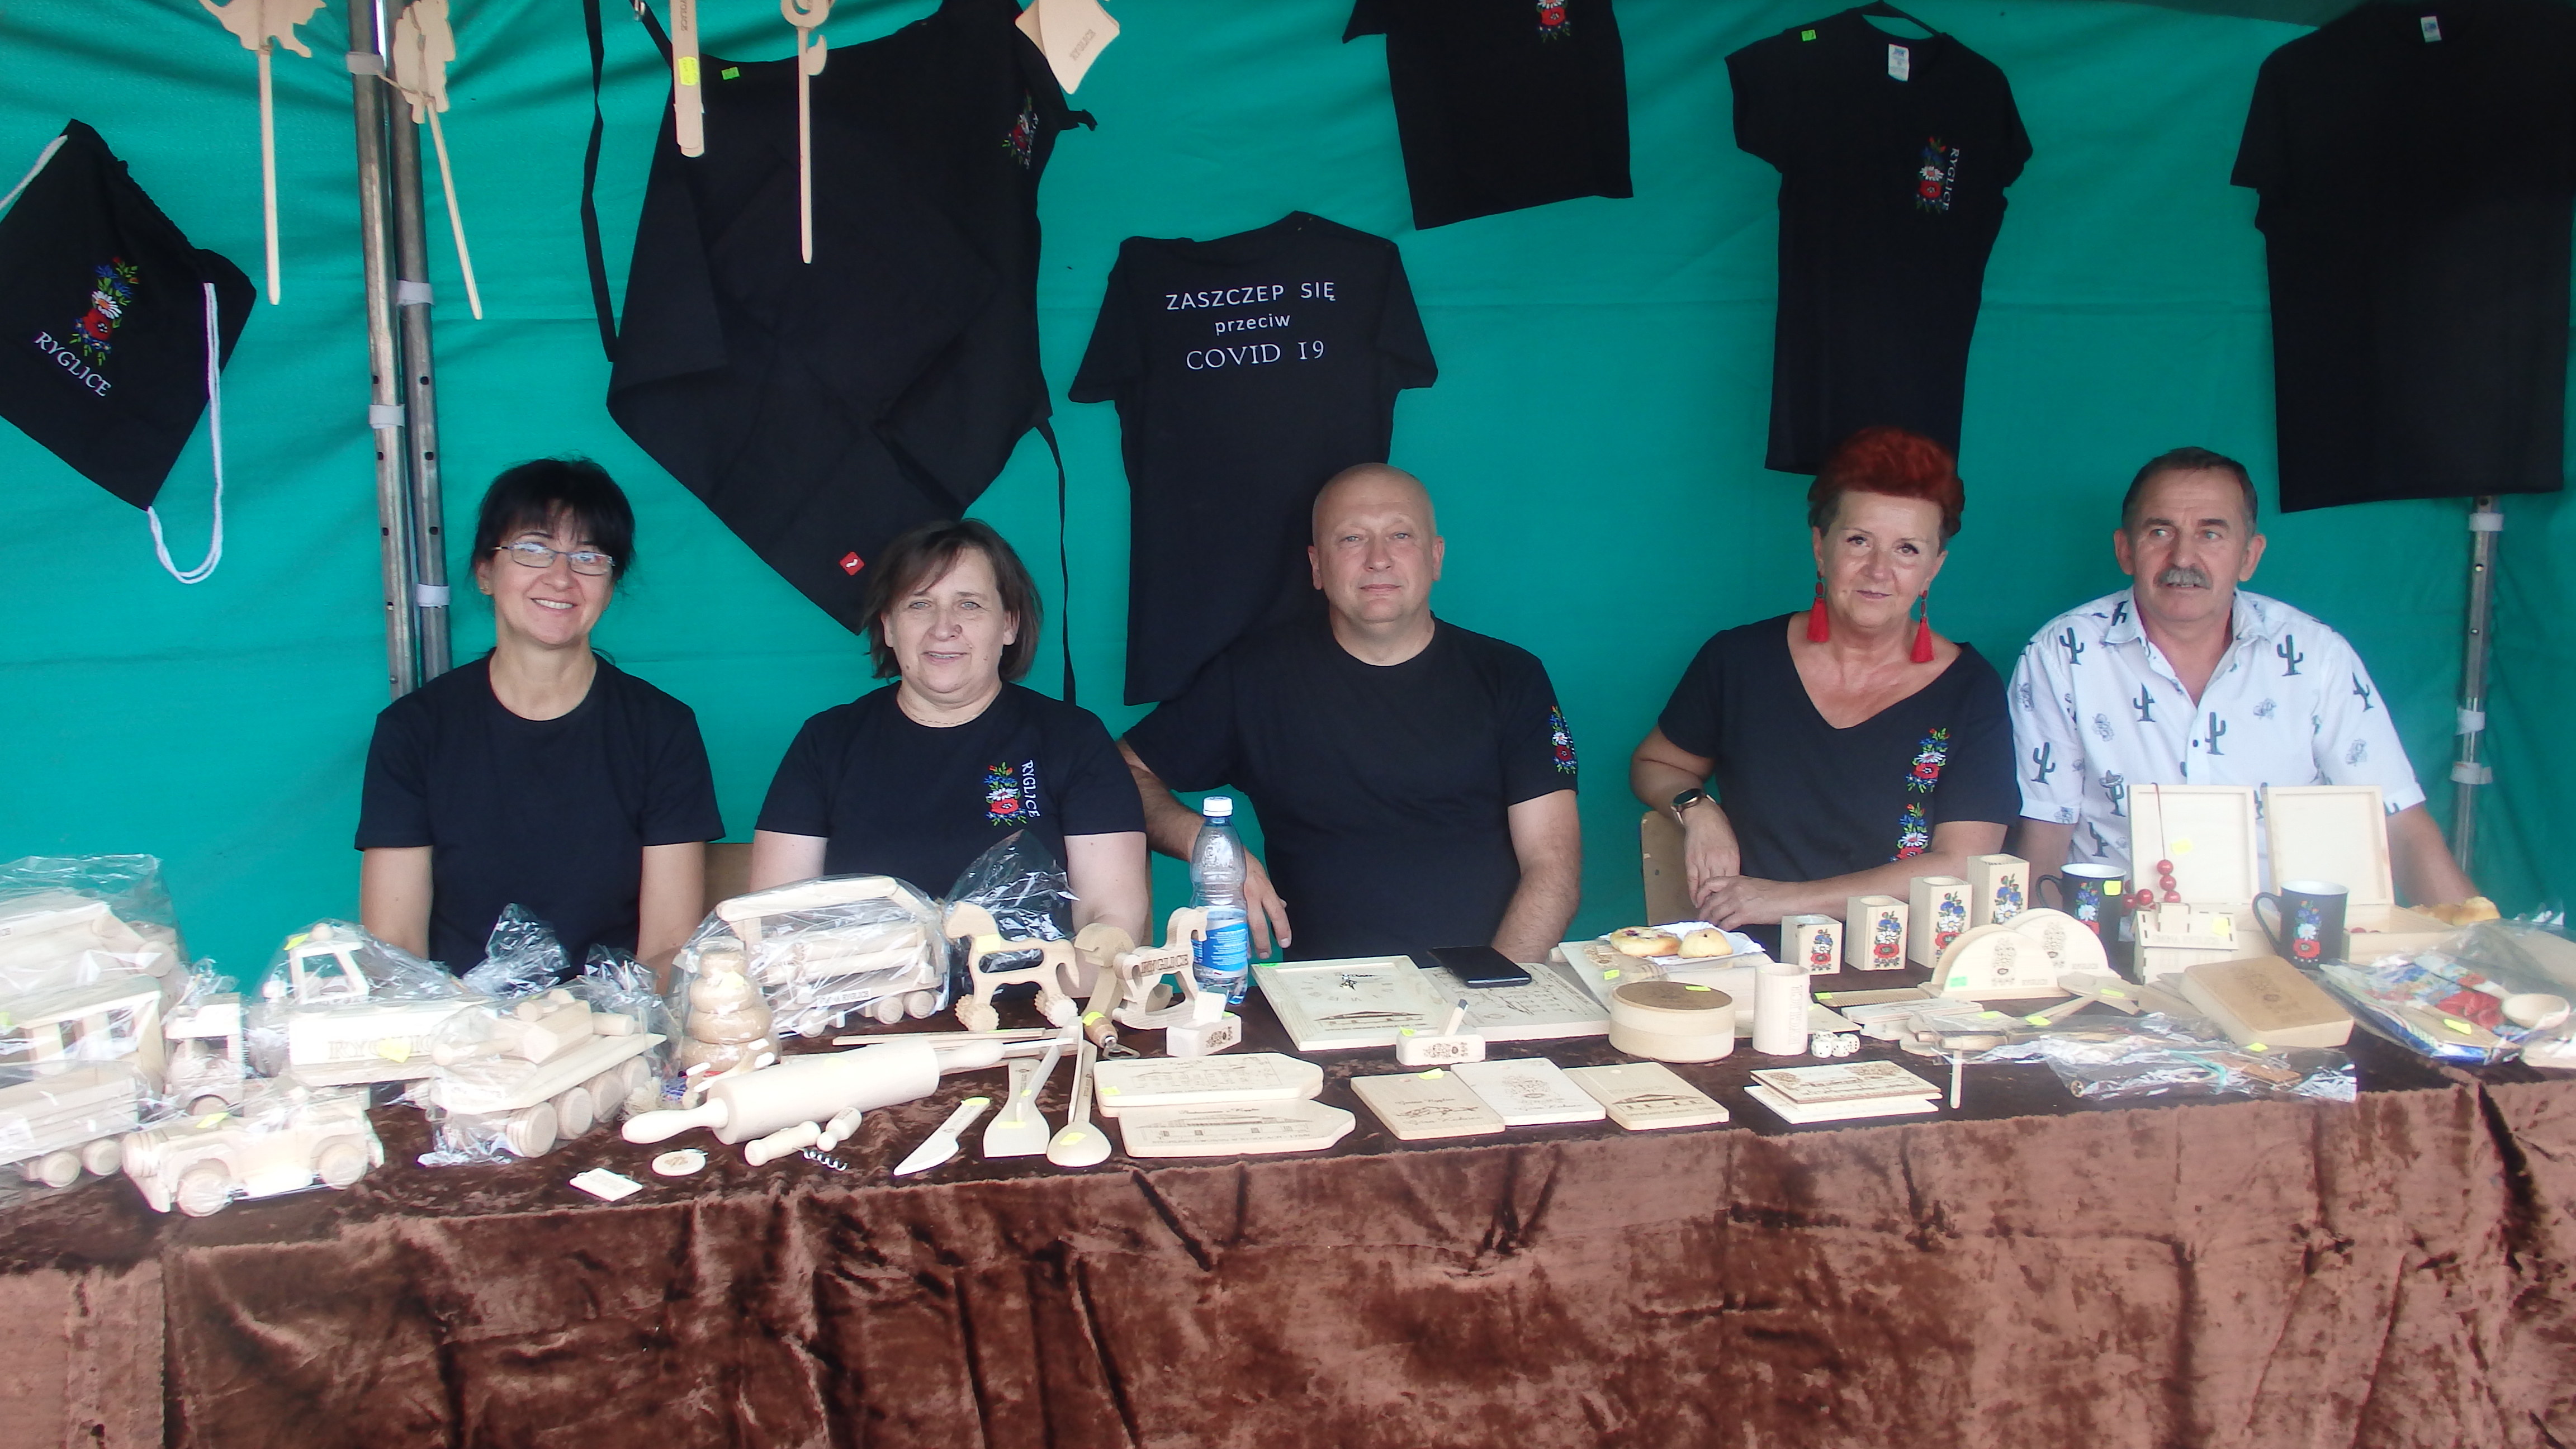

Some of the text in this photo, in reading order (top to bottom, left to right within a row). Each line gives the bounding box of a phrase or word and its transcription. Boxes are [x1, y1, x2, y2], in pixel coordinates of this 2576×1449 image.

[1942, 148, 1960, 211] RYGLICE
[1166, 282, 1336, 310] ZASZCZEP SIĘ
[1214, 314, 1290, 335] przeciw
[34, 331, 112, 397] RYGLICE
[1186, 343, 1281, 370] COVID
[1021, 759, 1041, 817] RYGLICE
[1141, 954, 1189, 973] RYGLICE
[1788, 985, 1803, 1045] RYGLICE
